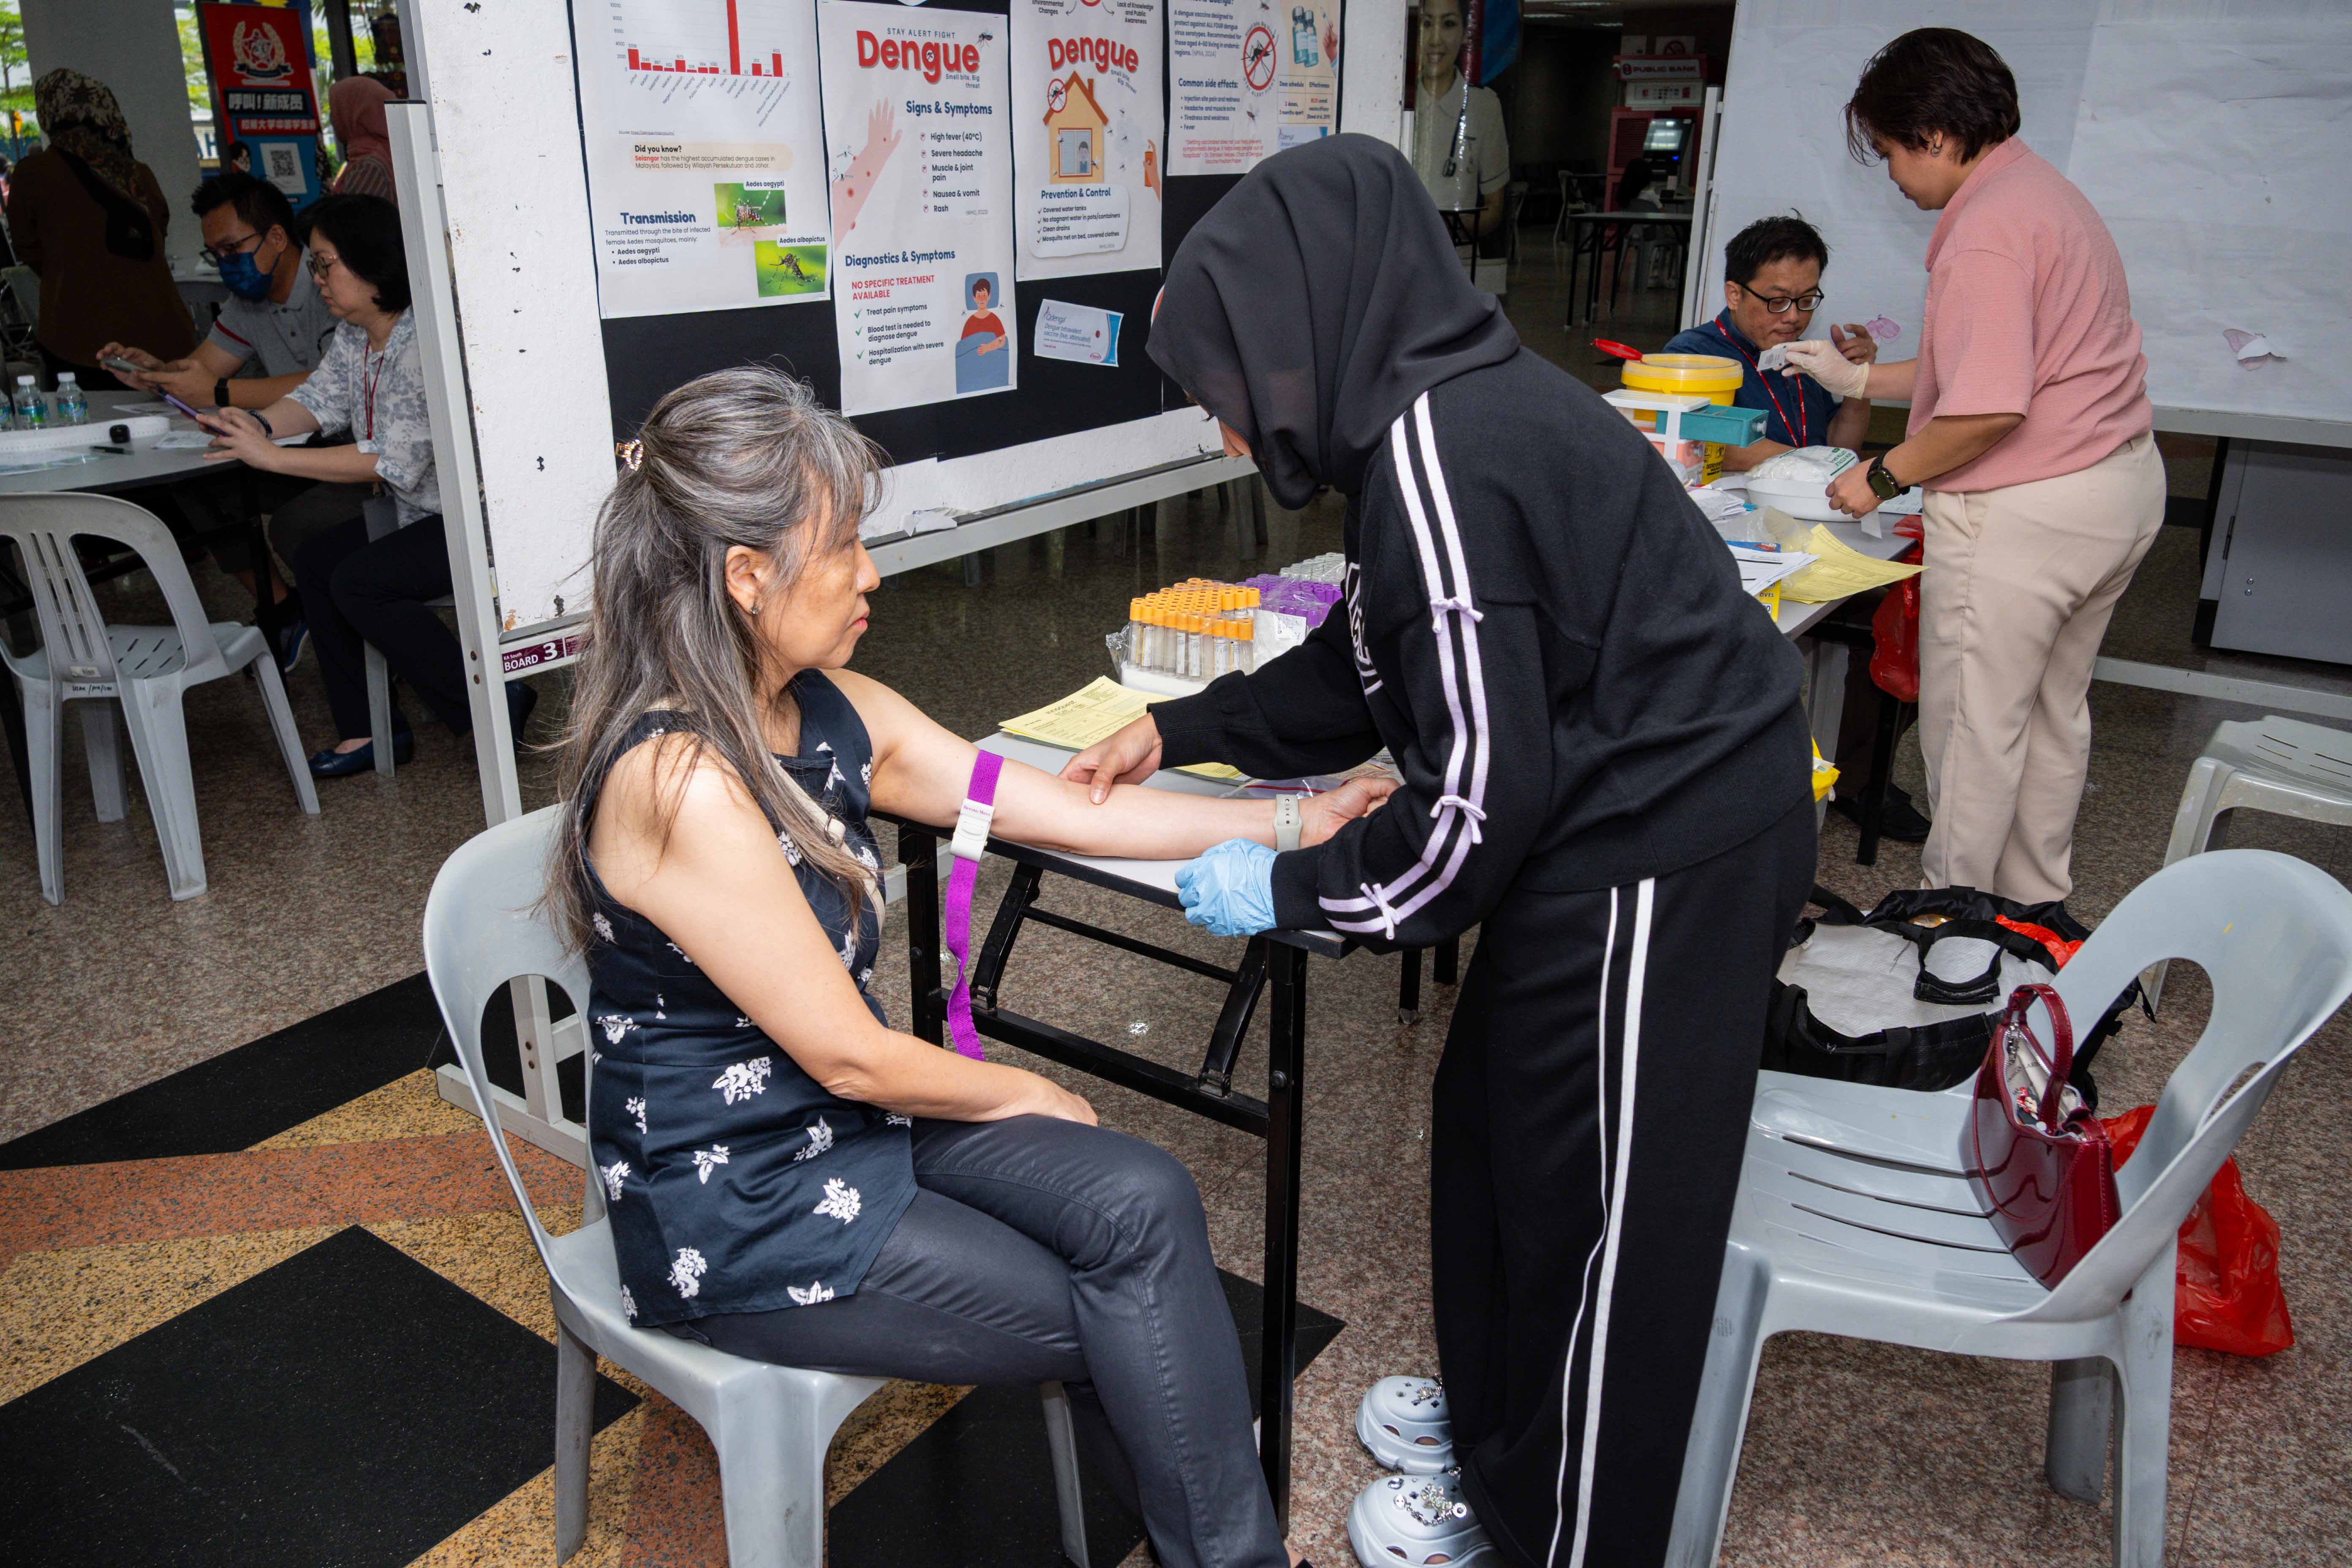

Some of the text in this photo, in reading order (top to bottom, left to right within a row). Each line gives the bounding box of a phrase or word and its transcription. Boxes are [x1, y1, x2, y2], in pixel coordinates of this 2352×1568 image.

[1039, 7, 1058, 16] Changes
[1132, 3, 1153, 11] Knowledge
[856, 30, 980, 84] Dengue
[1048, 37, 1139, 74] Dengue
[1179, 78, 1203, 87] Common
[1205, 79, 1216, 87] side
[906, 101, 992, 117] Signs & Symptoms
[931, 132, 945, 142] High
[960, 163, 973, 173] joint
[933, 174, 946, 183] pain
[1041, 188, 1111, 199] Prevention & Control
[620, 211, 696, 224] Transmission
[1087, 213, 1120, 221] pots/containers
[637, 247, 660, 255] aegypti
[638, 257, 669, 265] albopictus
[845, 250, 956, 269] Diagnostics & Symptoms
[852, 275, 935, 289] NO SPECIFIC TREATMENT
[853, 289, 890, 300] AVAILABLE
[883, 306, 896, 316] pain
[897, 304, 927, 314] symptoms
[868, 325, 884, 333] Blood
[903, 321, 924, 329] needed
[868, 331, 917, 343] diagnose dengue
[869, 345, 912, 357] Hospitalization
[543, 642, 558, 660] 3
[504, 654, 539, 671] BOARD
